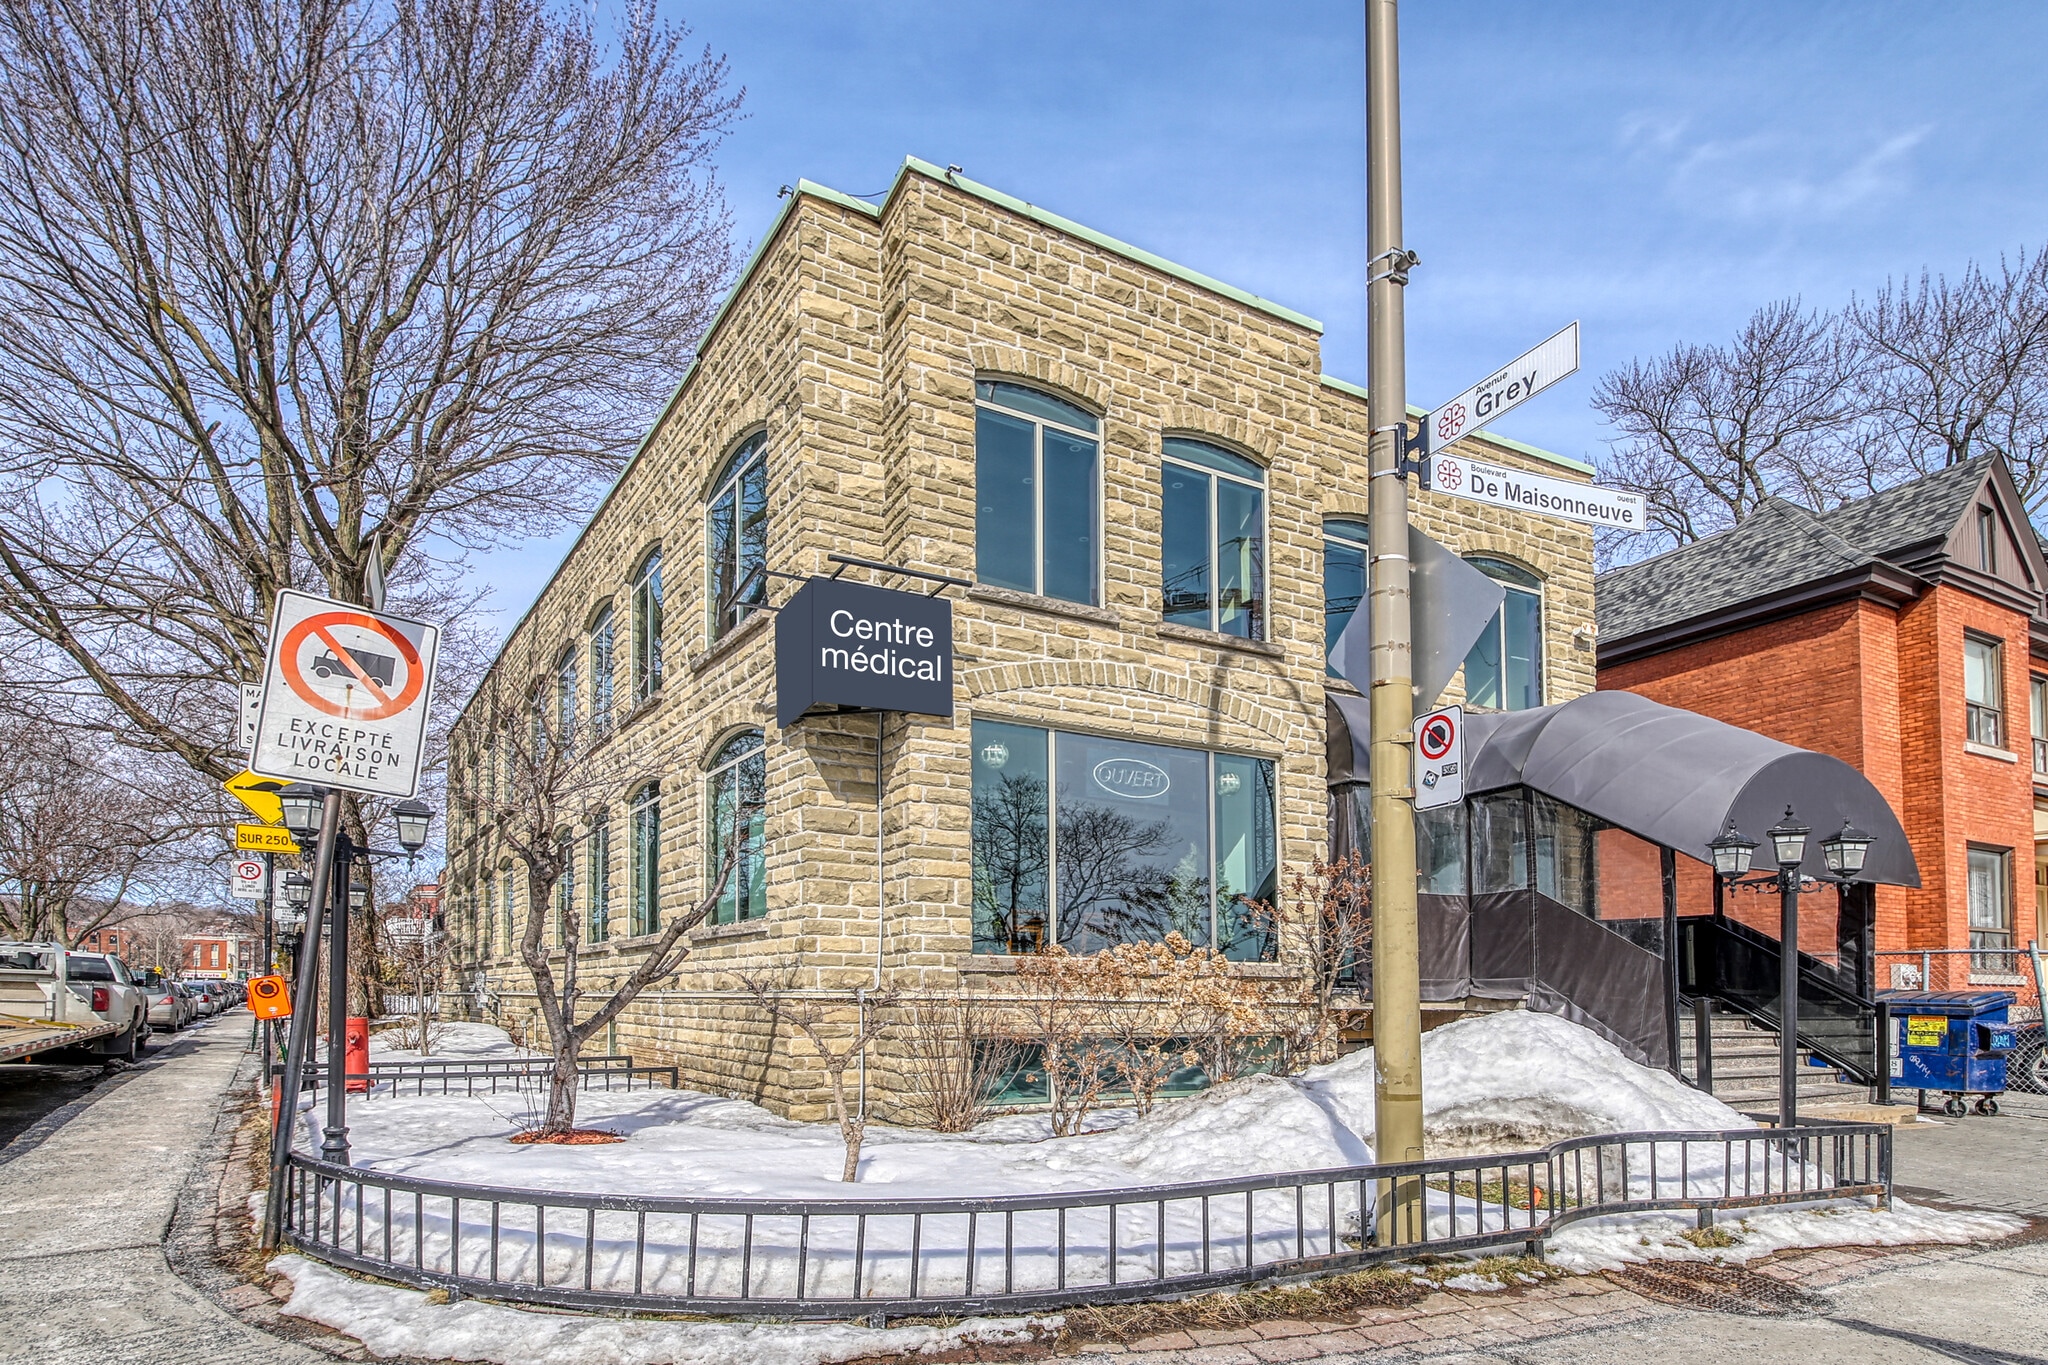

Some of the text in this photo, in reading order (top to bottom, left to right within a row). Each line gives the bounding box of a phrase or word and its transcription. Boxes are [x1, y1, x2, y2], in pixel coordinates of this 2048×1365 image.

[1475, 371, 1508, 396] Avenue
[1475, 369, 1537, 418] Grey
[1470, 463, 1507, 479] Boulevard
[1470, 474, 1633, 523] De Maisonneuve
[1616, 495, 1637, 505] ouest
[830, 609, 934, 648] Centre
[821, 645, 942, 682] médical
[290, 718, 393, 750] EXCEPTÉ
[278, 733, 400, 767] LIVRAISON
[294, 753, 380, 780] LOCALE
[1098, 766, 1163, 788] OUVERT
[240, 833, 263, 844] SUR
[266, 835, 289, 846] 250
